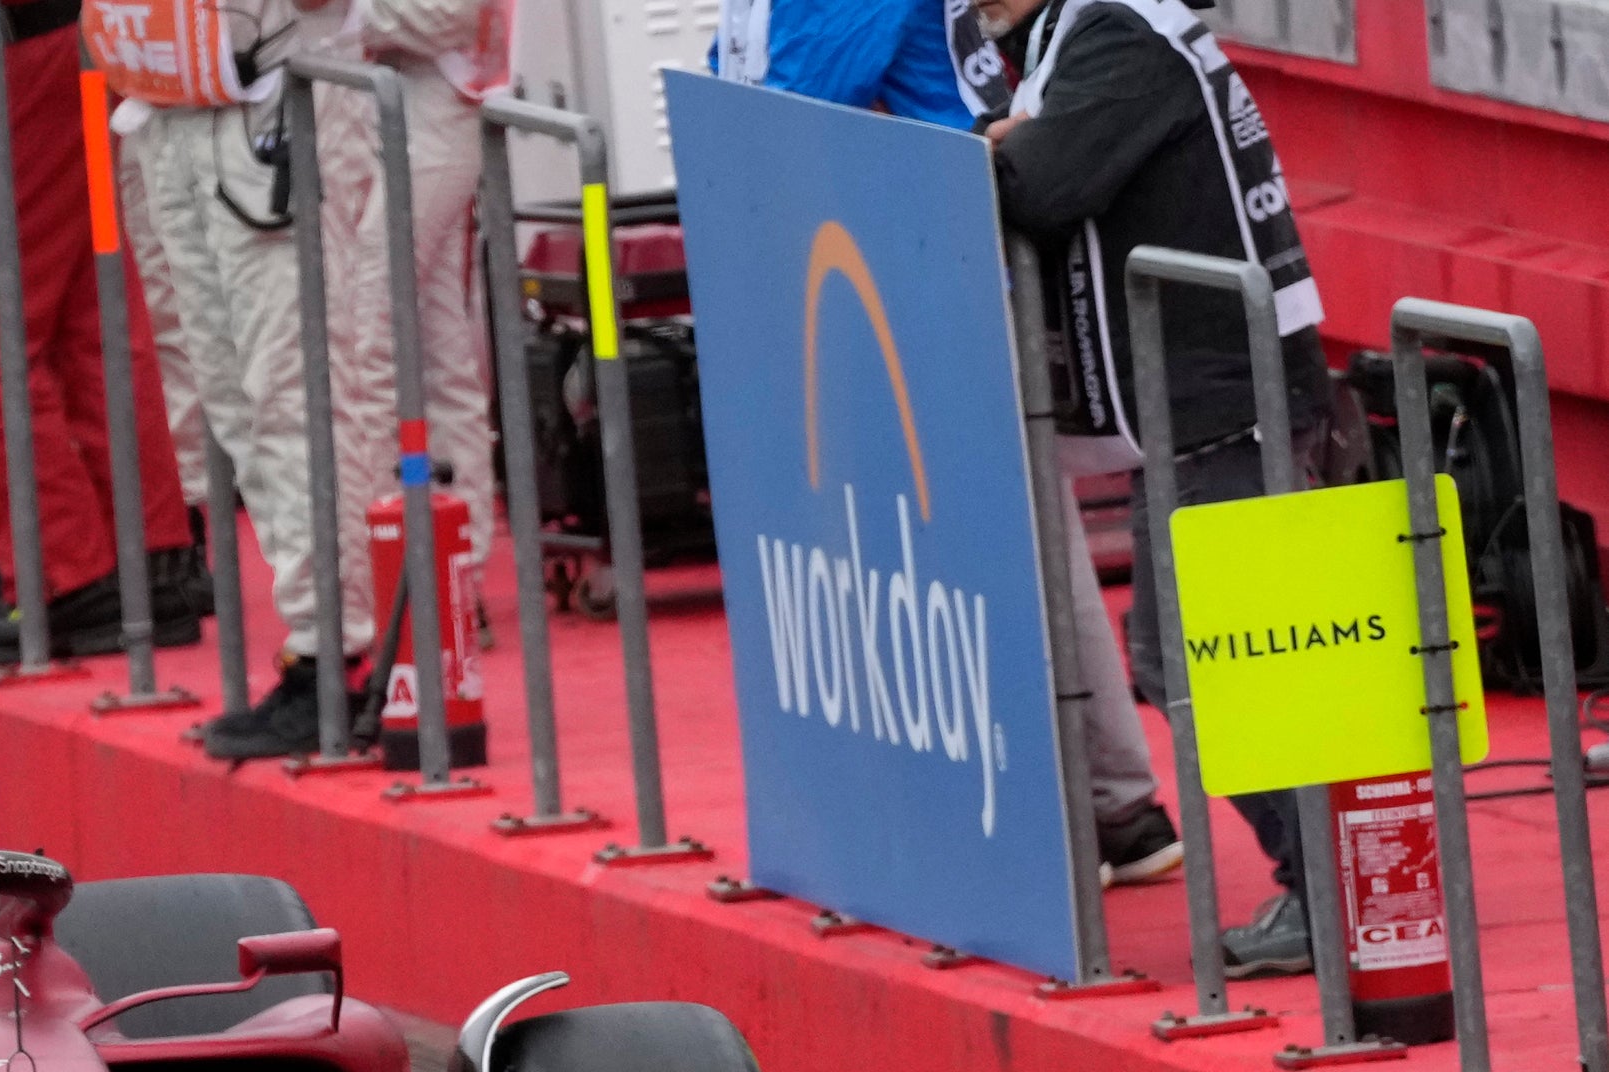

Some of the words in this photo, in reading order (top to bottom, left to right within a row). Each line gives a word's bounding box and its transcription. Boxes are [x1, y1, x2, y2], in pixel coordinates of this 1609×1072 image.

[757, 483, 995, 838] workday
[1187, 614, 1388, 664] WILLIAMS
[1362, 921, 1443, 944] CEA
